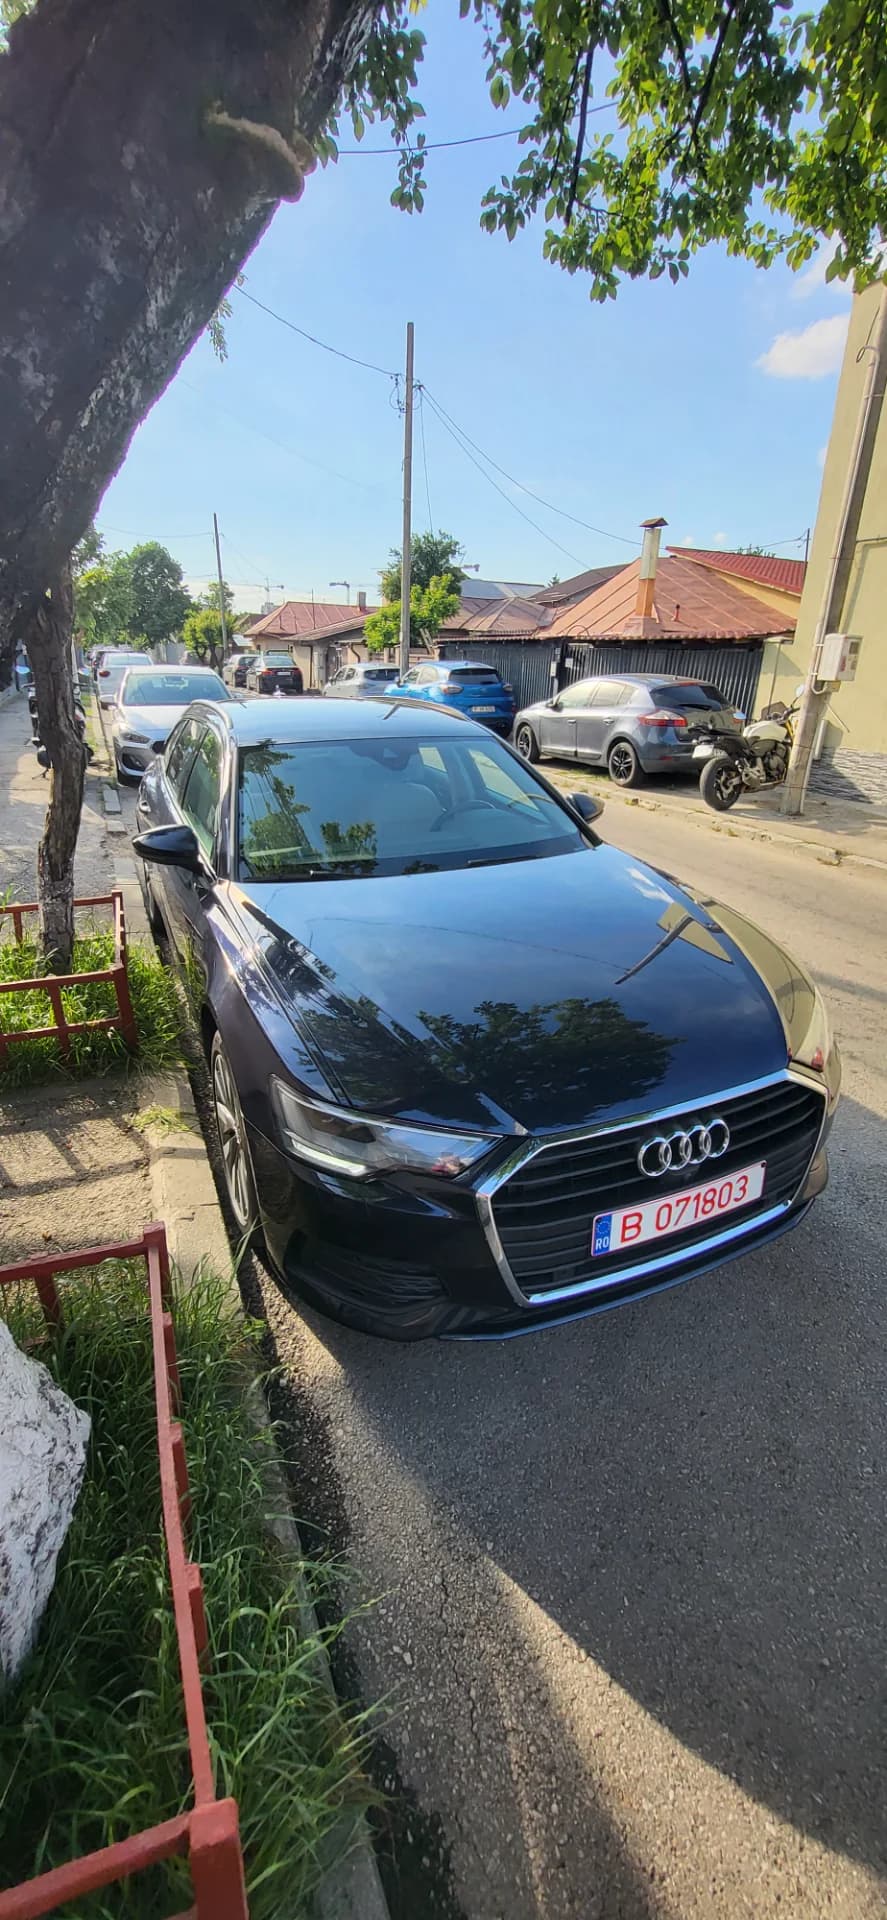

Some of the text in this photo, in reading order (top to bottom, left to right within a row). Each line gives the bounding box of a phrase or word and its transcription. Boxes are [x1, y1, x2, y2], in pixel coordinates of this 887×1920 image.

[620, 1175, 749, 1243] B 071803
[595, 1236, 609, 1250] RO
